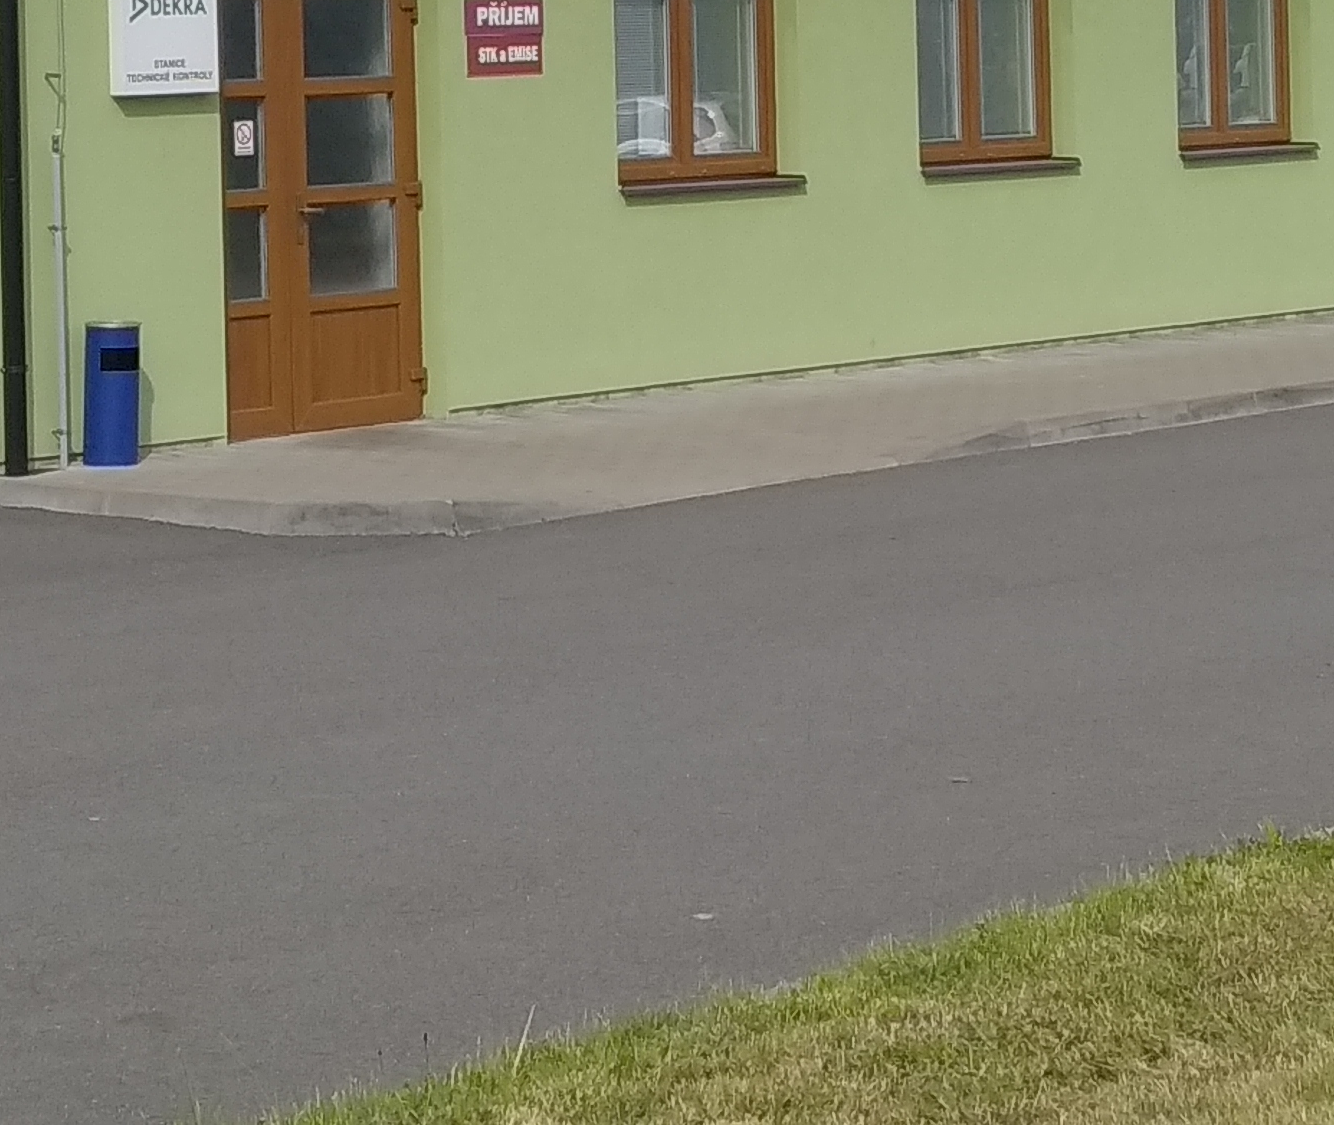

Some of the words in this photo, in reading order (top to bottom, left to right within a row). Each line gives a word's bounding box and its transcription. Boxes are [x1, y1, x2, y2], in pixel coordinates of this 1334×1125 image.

[476, 0, 539, 26] PŘÍJEM
[478, 47, 498, 64] STK
[499, 49, 507, 63] a
[507, 45, 539, 63] EMISE
